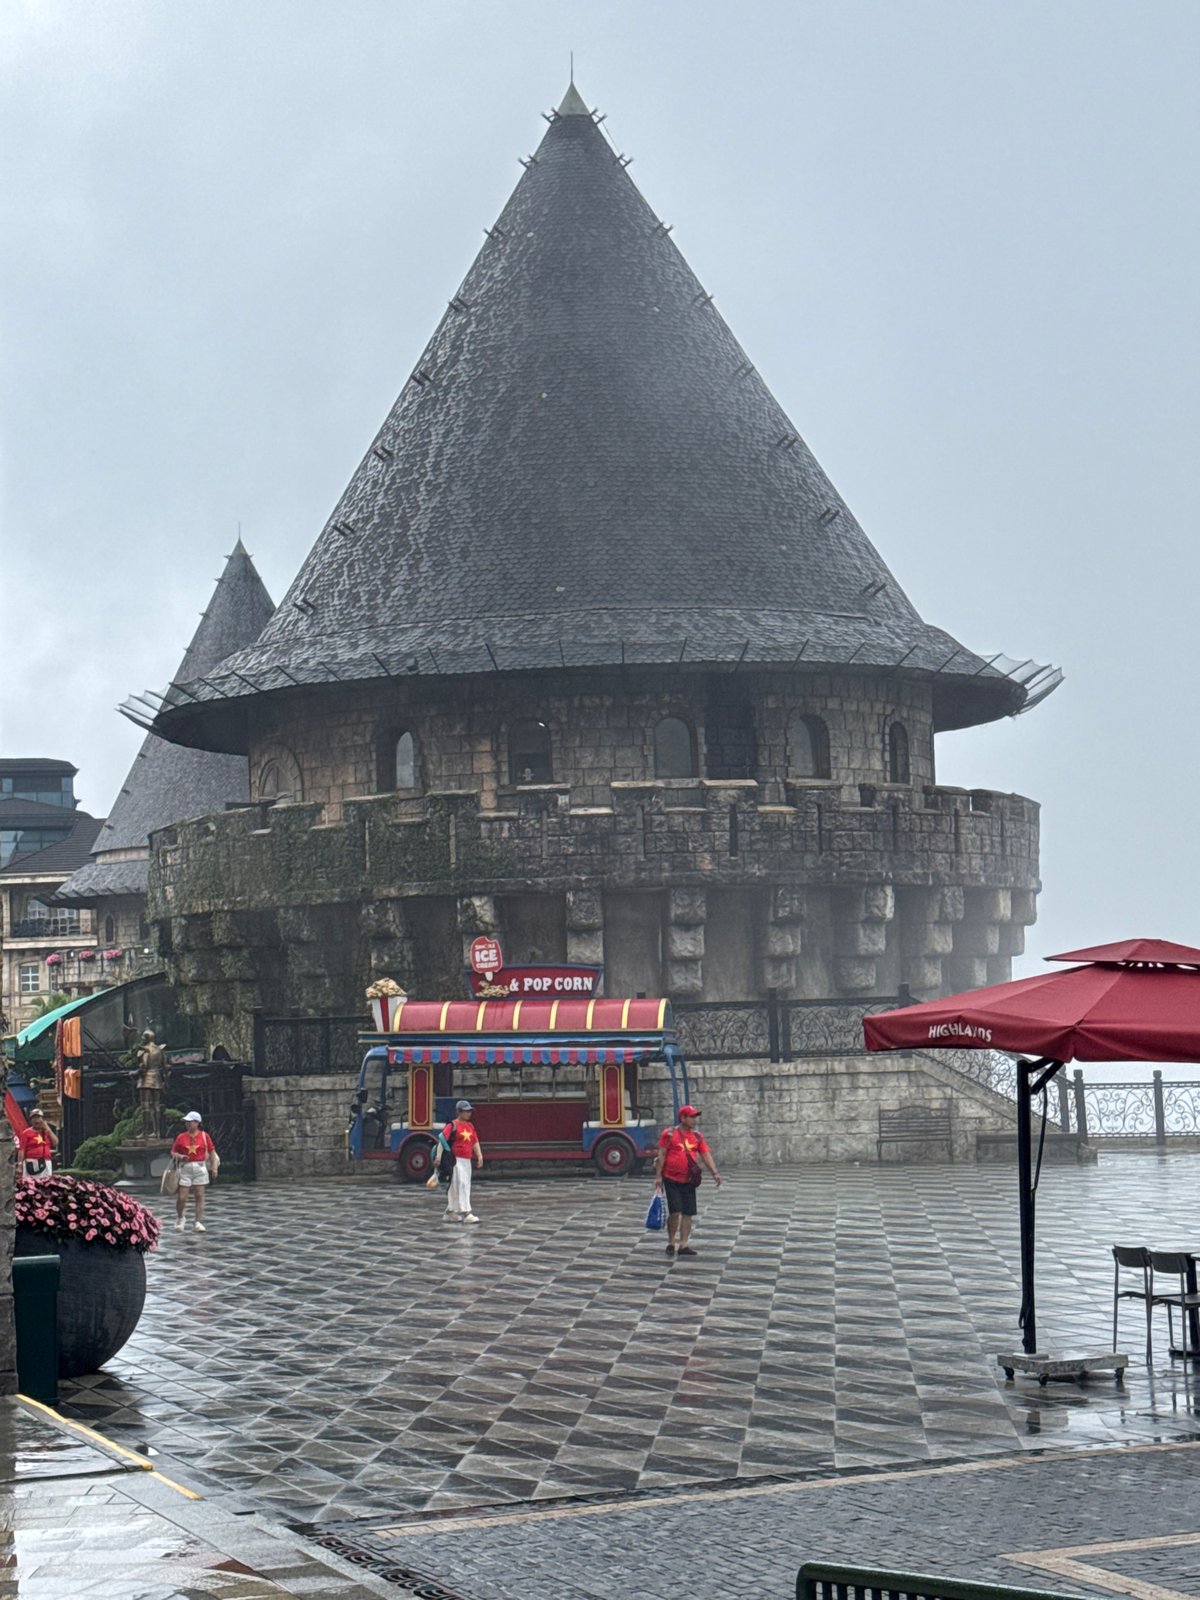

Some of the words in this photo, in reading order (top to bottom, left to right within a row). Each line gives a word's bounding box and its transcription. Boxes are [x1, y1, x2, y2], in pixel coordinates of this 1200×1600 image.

[475, 949, 498, 962] ICE
[509, 978, 519, 992] &
[523, 977, 552, 991] POP
[554, 976, 593, 991] CORN
